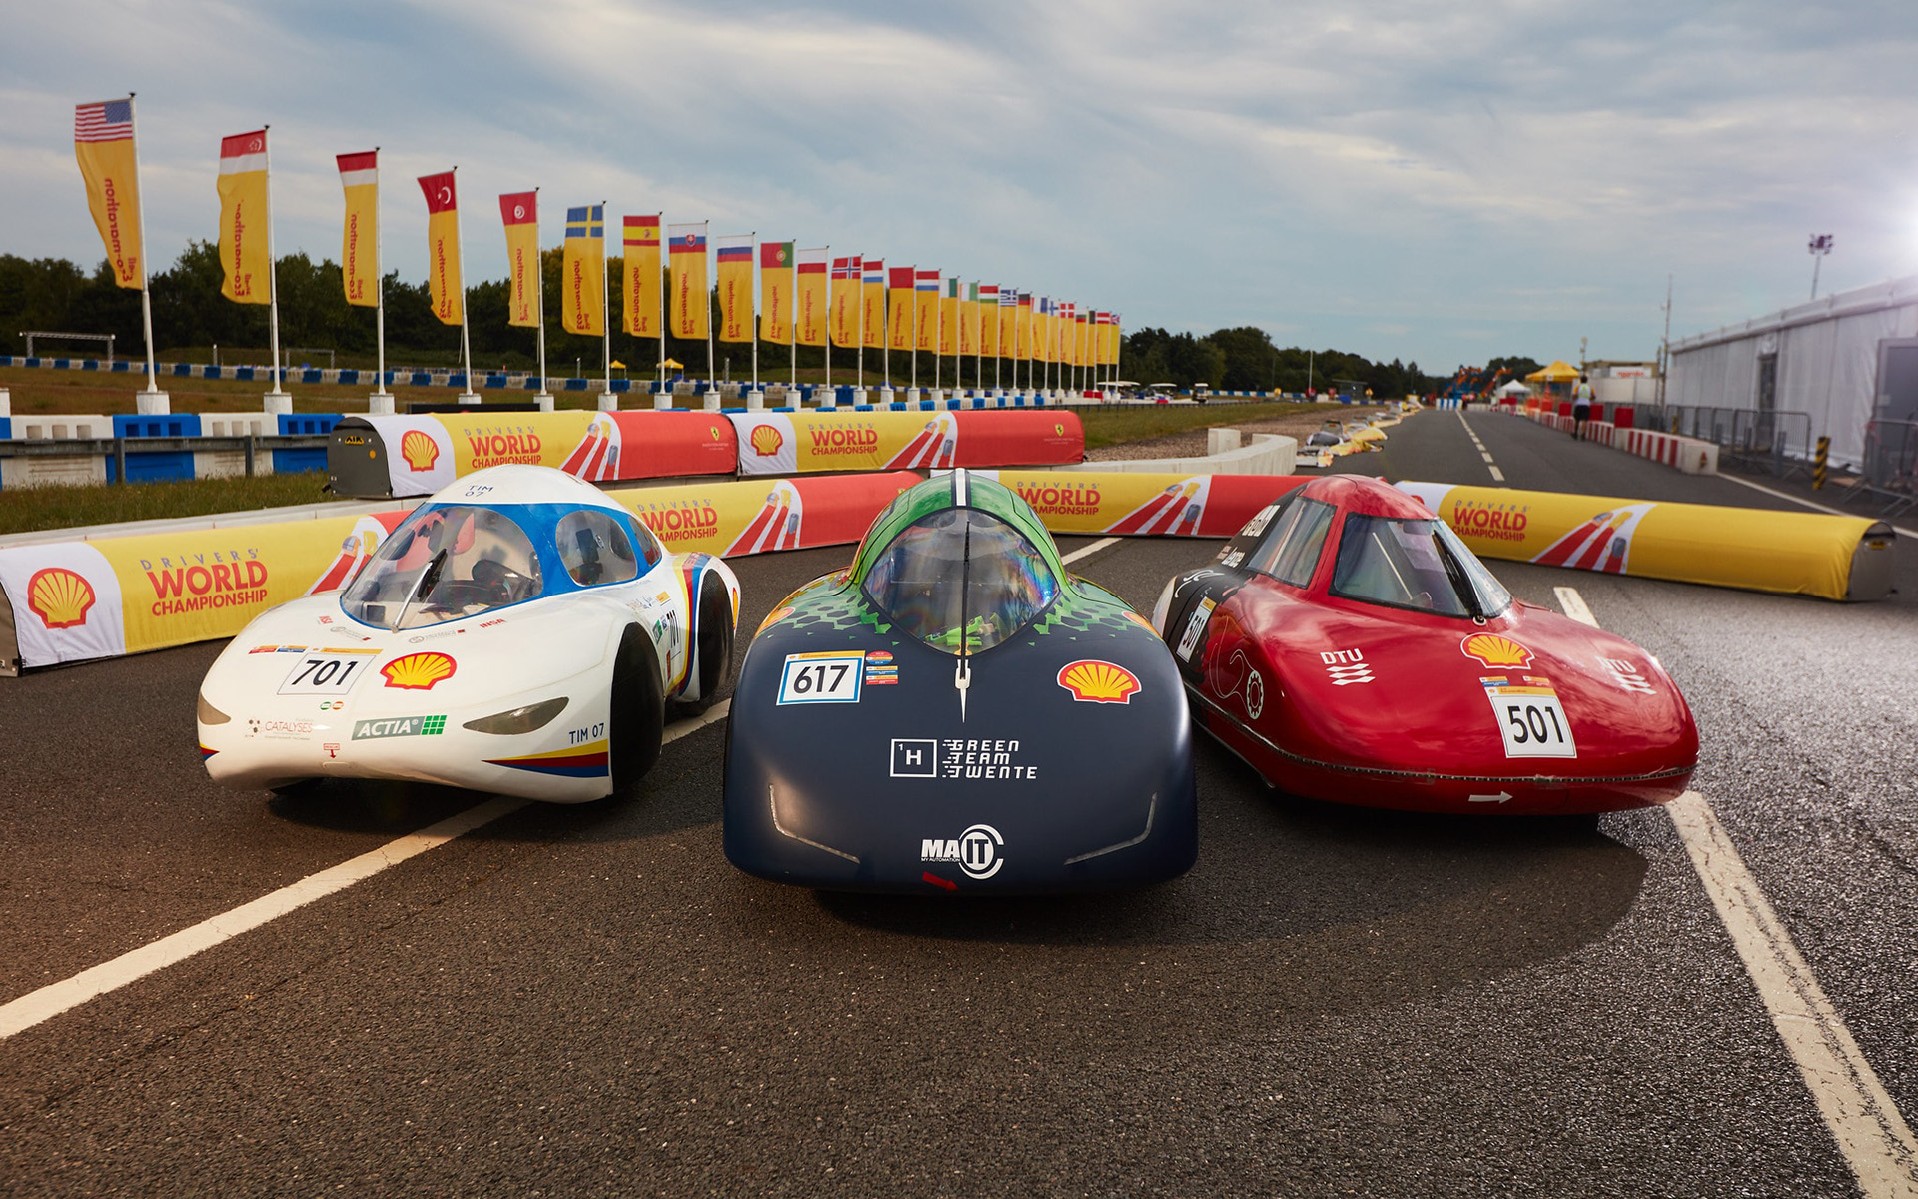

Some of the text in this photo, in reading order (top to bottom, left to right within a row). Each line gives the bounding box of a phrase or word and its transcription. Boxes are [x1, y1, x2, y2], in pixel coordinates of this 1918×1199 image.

[468, 434, 541, 457] WORLD
[811, 430, 877, 446] WORLD
[812, 446, 877, 455] CHAMPIONSHIP
[472, 455, 541, 468] CHAMPIONSHIP
[1017, 488, 1101, 505] WORLD
[1033, 506, 1099, 515] AMPIONSHIP
[641, 508, 717, 531] WORLD
[1454, 507, 1527, 531] WORLD
[655, 528, 718, 542] AMPIONSHIP
[140, 549, 259, 571] DRIVERS'
[147, 561, 268, 599] WORLD
[152, 589, 267, 616] CHAMPIONSHIP
[1320, 648, 1363, 664] DTU
[292, 660, 358, 685] 701
[793, 665, 849, 693] 617
[265, 721, 312, 733] CATALYSES
[1507, 705, 1563, 743] 501
[569, 722, 604, 744] TIM 07
[945, 740, 1019, 752] GREEN
[906, 750, 921, 765] H
[944, 752, 1010, 764] TEAM
[944, 766, 1038, 779] TWENTE
